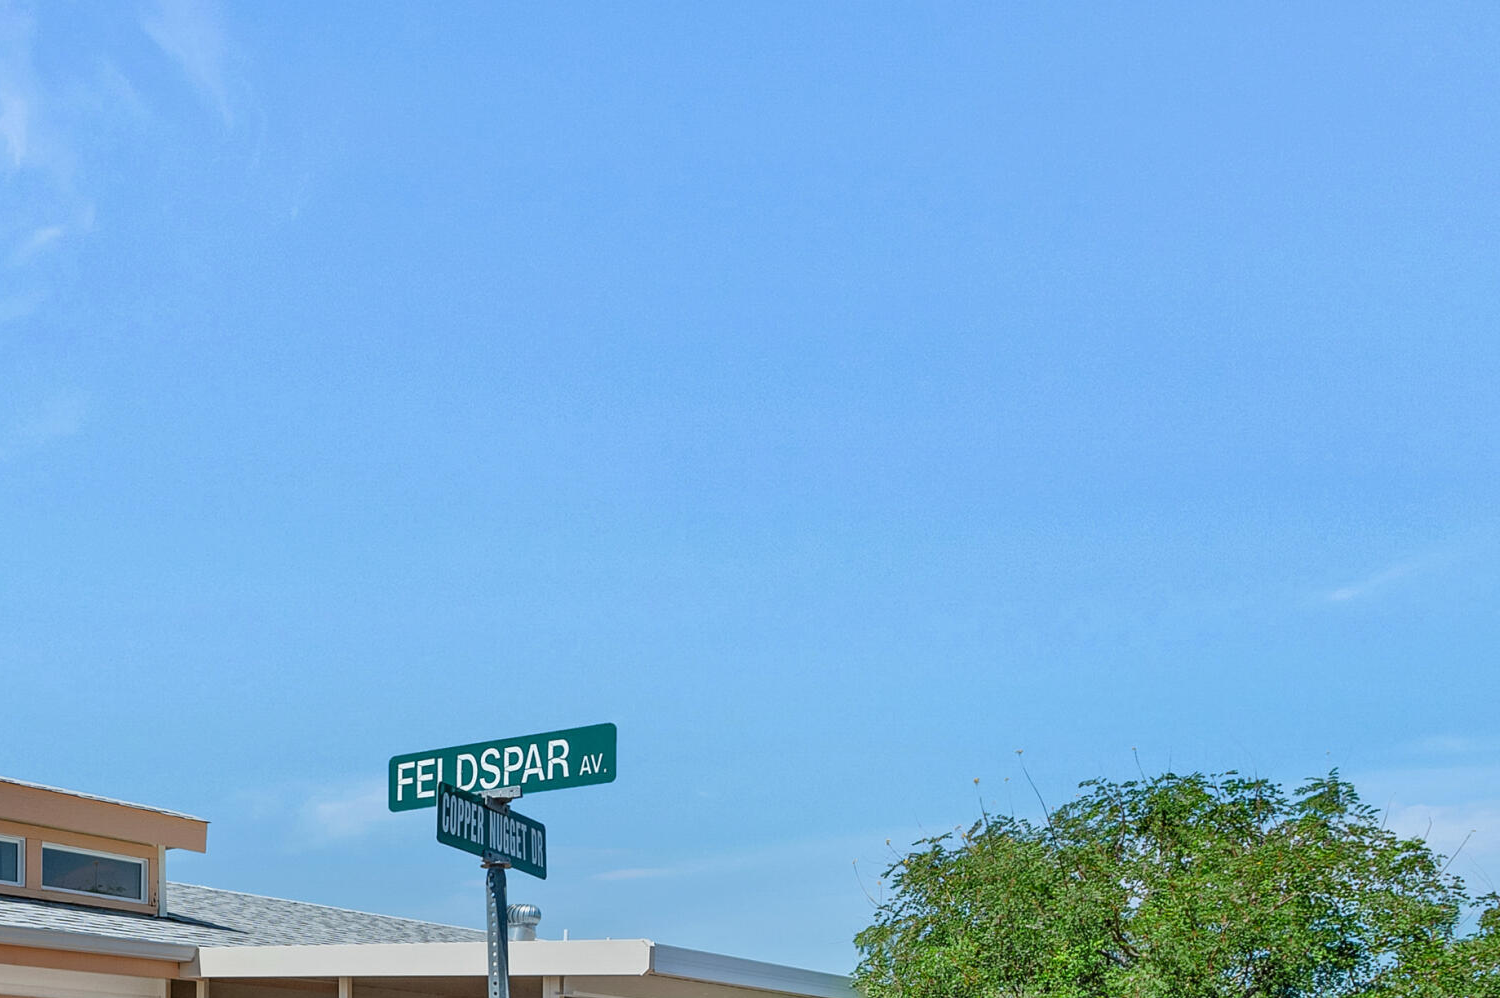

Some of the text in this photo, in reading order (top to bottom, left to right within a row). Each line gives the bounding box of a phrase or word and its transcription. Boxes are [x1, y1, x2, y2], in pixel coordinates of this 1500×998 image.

[579, 753, 608, 776] AV.
[442, 791, 544, 868] COPPER NUGGET DR
